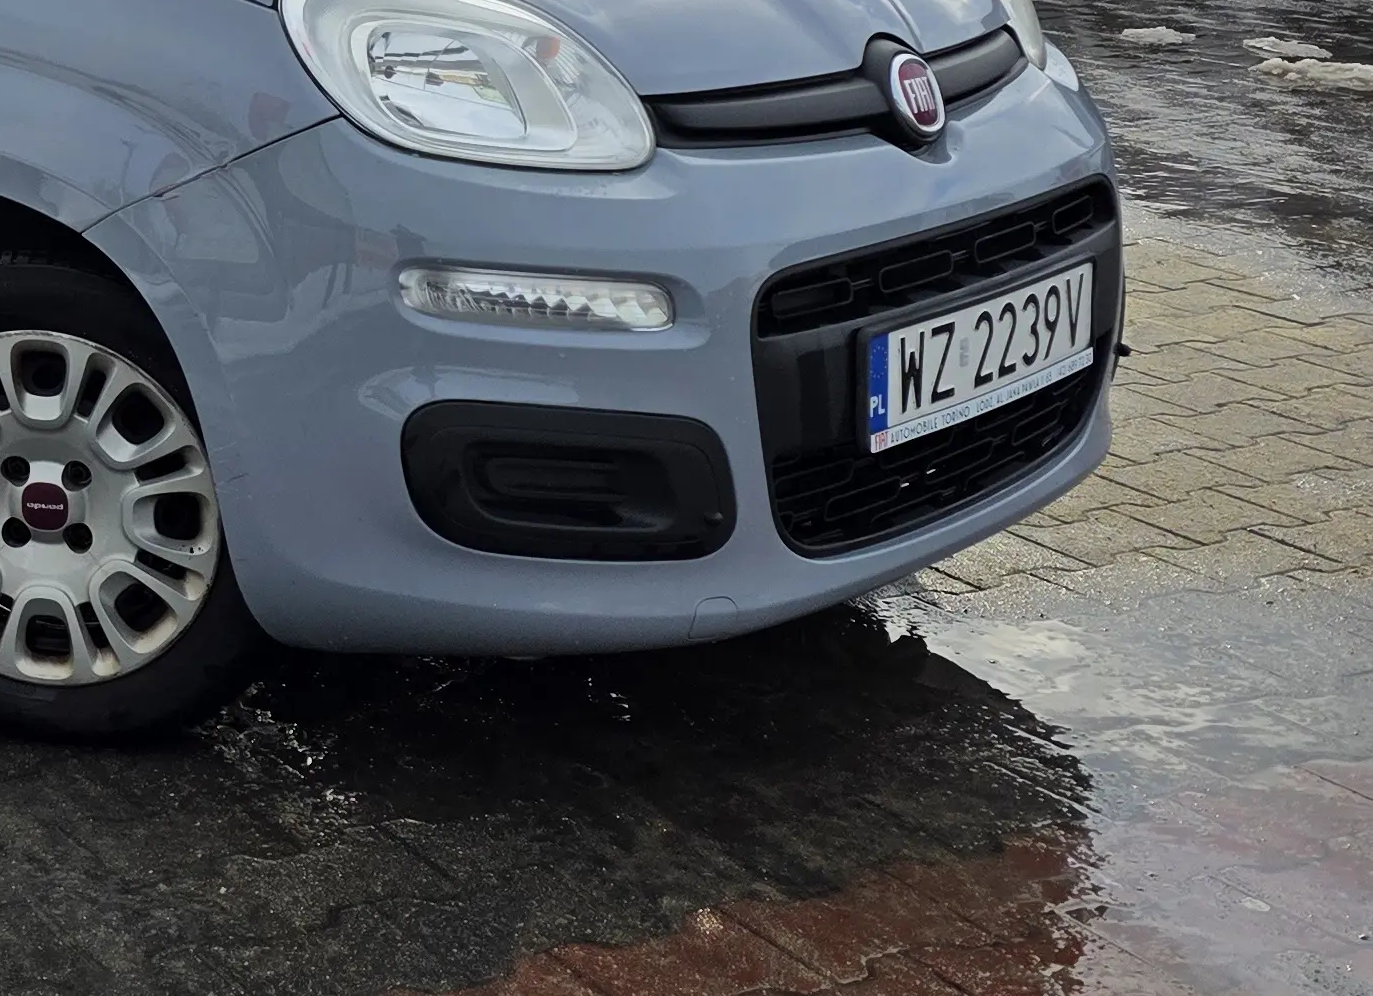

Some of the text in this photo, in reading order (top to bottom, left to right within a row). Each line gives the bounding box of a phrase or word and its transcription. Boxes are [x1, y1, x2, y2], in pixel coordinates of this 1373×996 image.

[903, 76, 936, 114] FIAT
[899, 273, 1085, 415] WZ 2239V
[869, 394, 886, 418] PL
[890, 416, 938, 444] AUTOMOBILE
